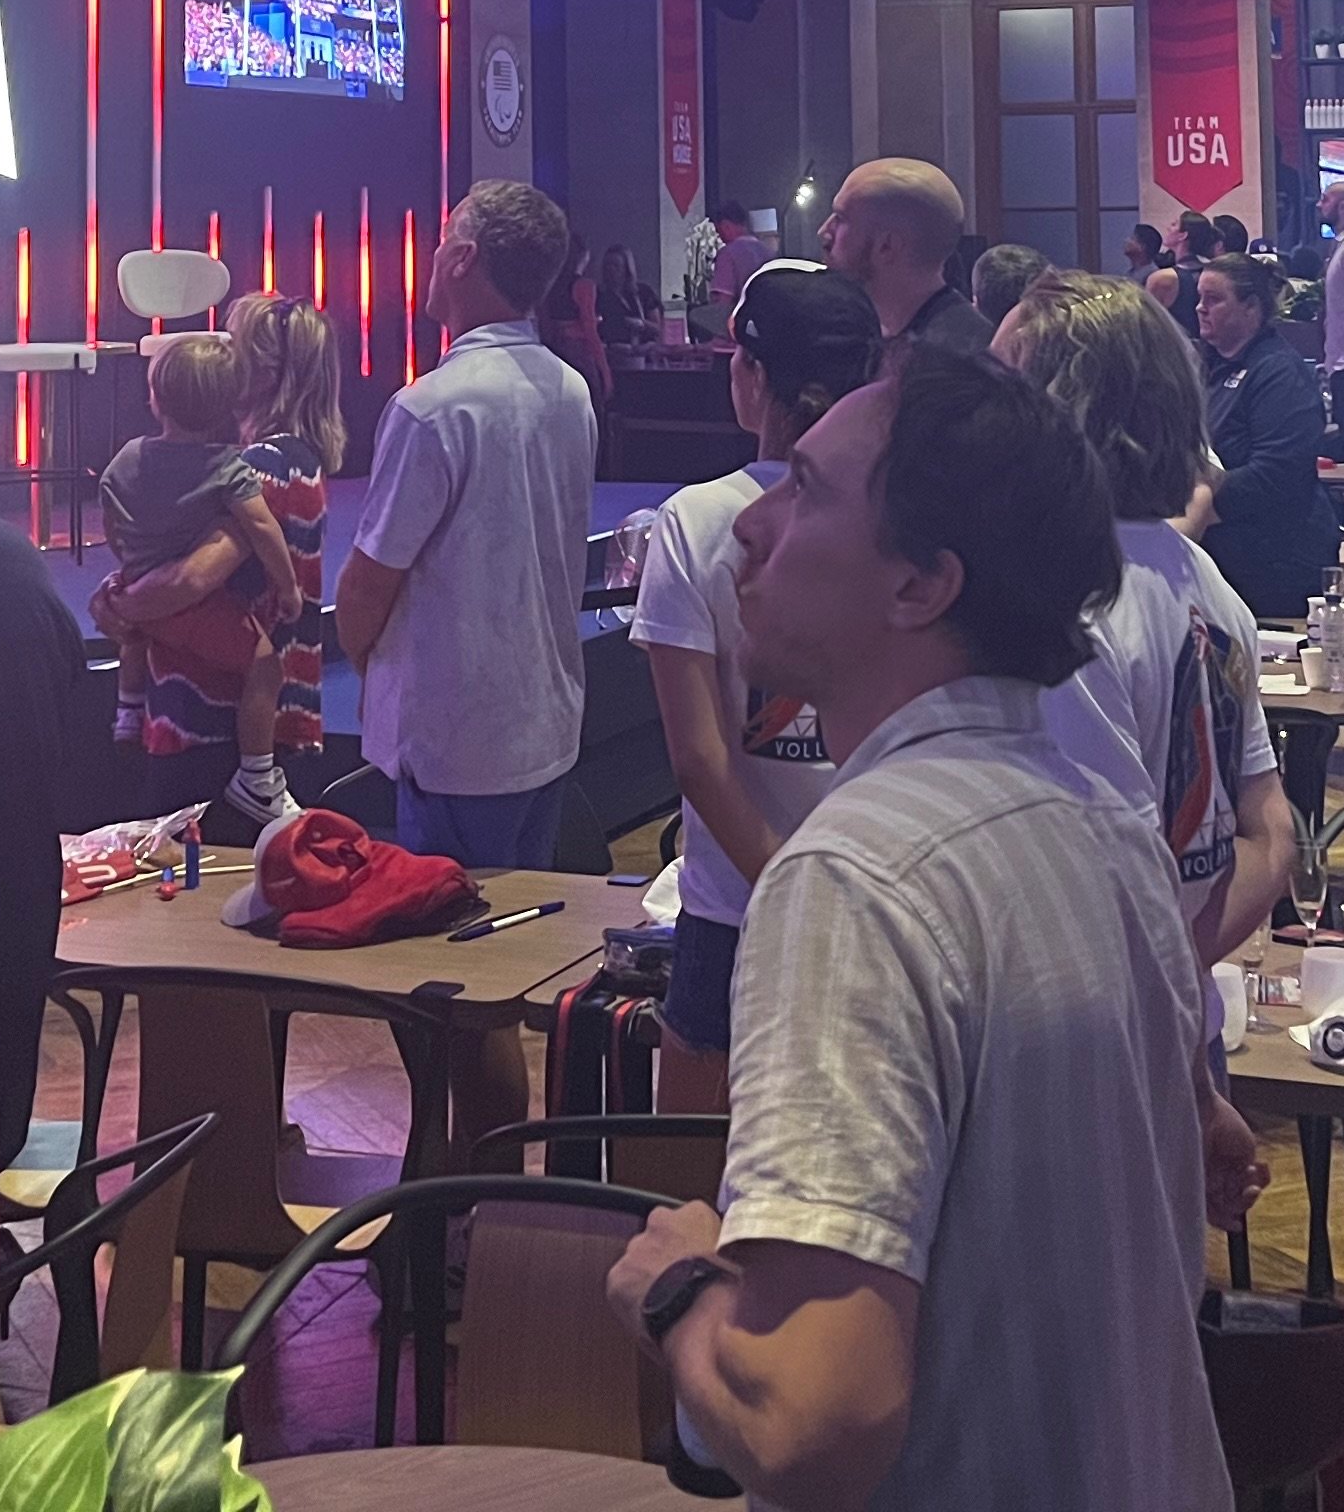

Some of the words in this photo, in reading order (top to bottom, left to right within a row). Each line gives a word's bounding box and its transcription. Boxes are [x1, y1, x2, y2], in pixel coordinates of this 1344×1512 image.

[1174, 116, 1219, 130] TEAM
[1167, 132, 1229, 167] USA
[775, 740, 823, 758] VOLL
